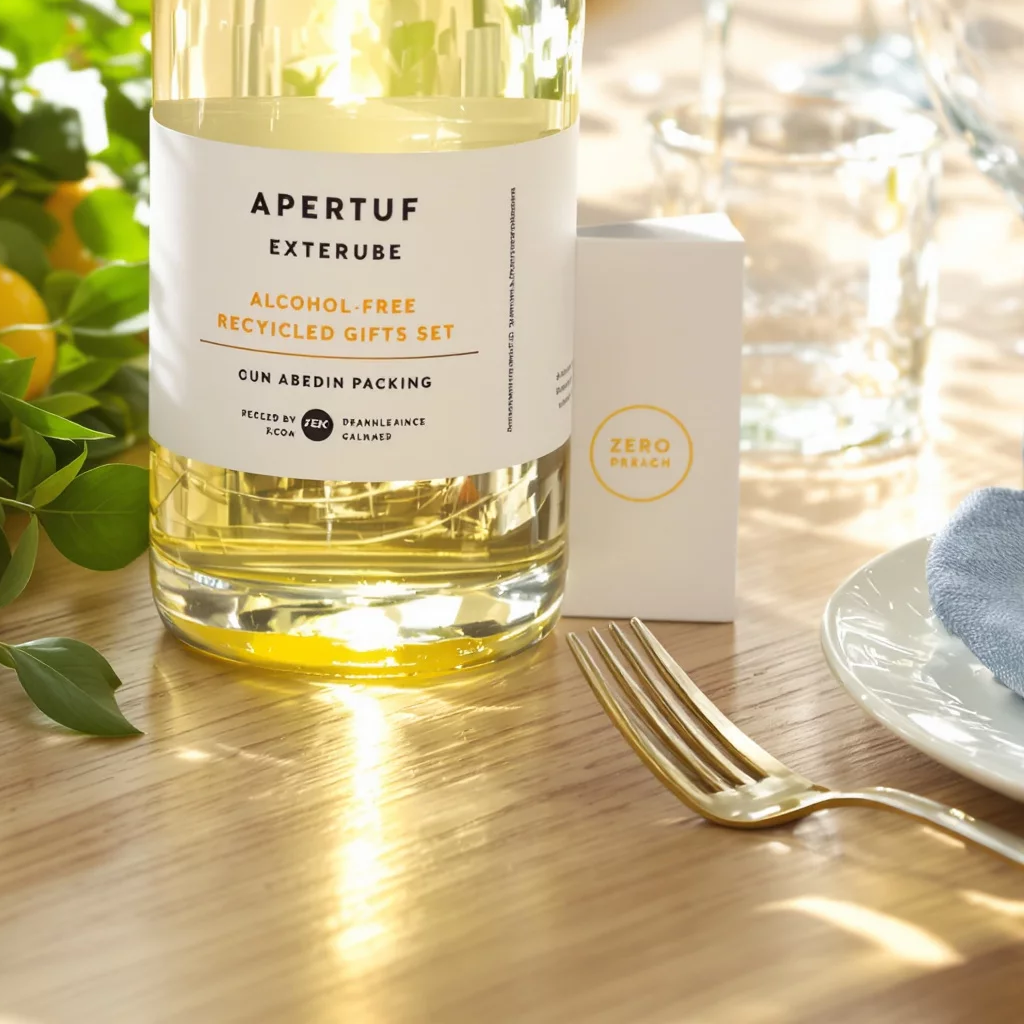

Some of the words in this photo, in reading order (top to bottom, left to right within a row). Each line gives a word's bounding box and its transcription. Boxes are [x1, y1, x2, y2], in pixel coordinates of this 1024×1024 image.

[250, 191, 419, 222] APERTUF
[269, 238, 402, 261] EXTERUBE
[249, 291, 416, 314] ALCOHOL-FREE
[343, 326, 407, 342] GIFTS
[416, 323, 455, 342] SET
[278, 373, 344, 389] ABEDIN
[352, 376, 432, 390] PACKING
[609, 437, 671, 454] ZERO
